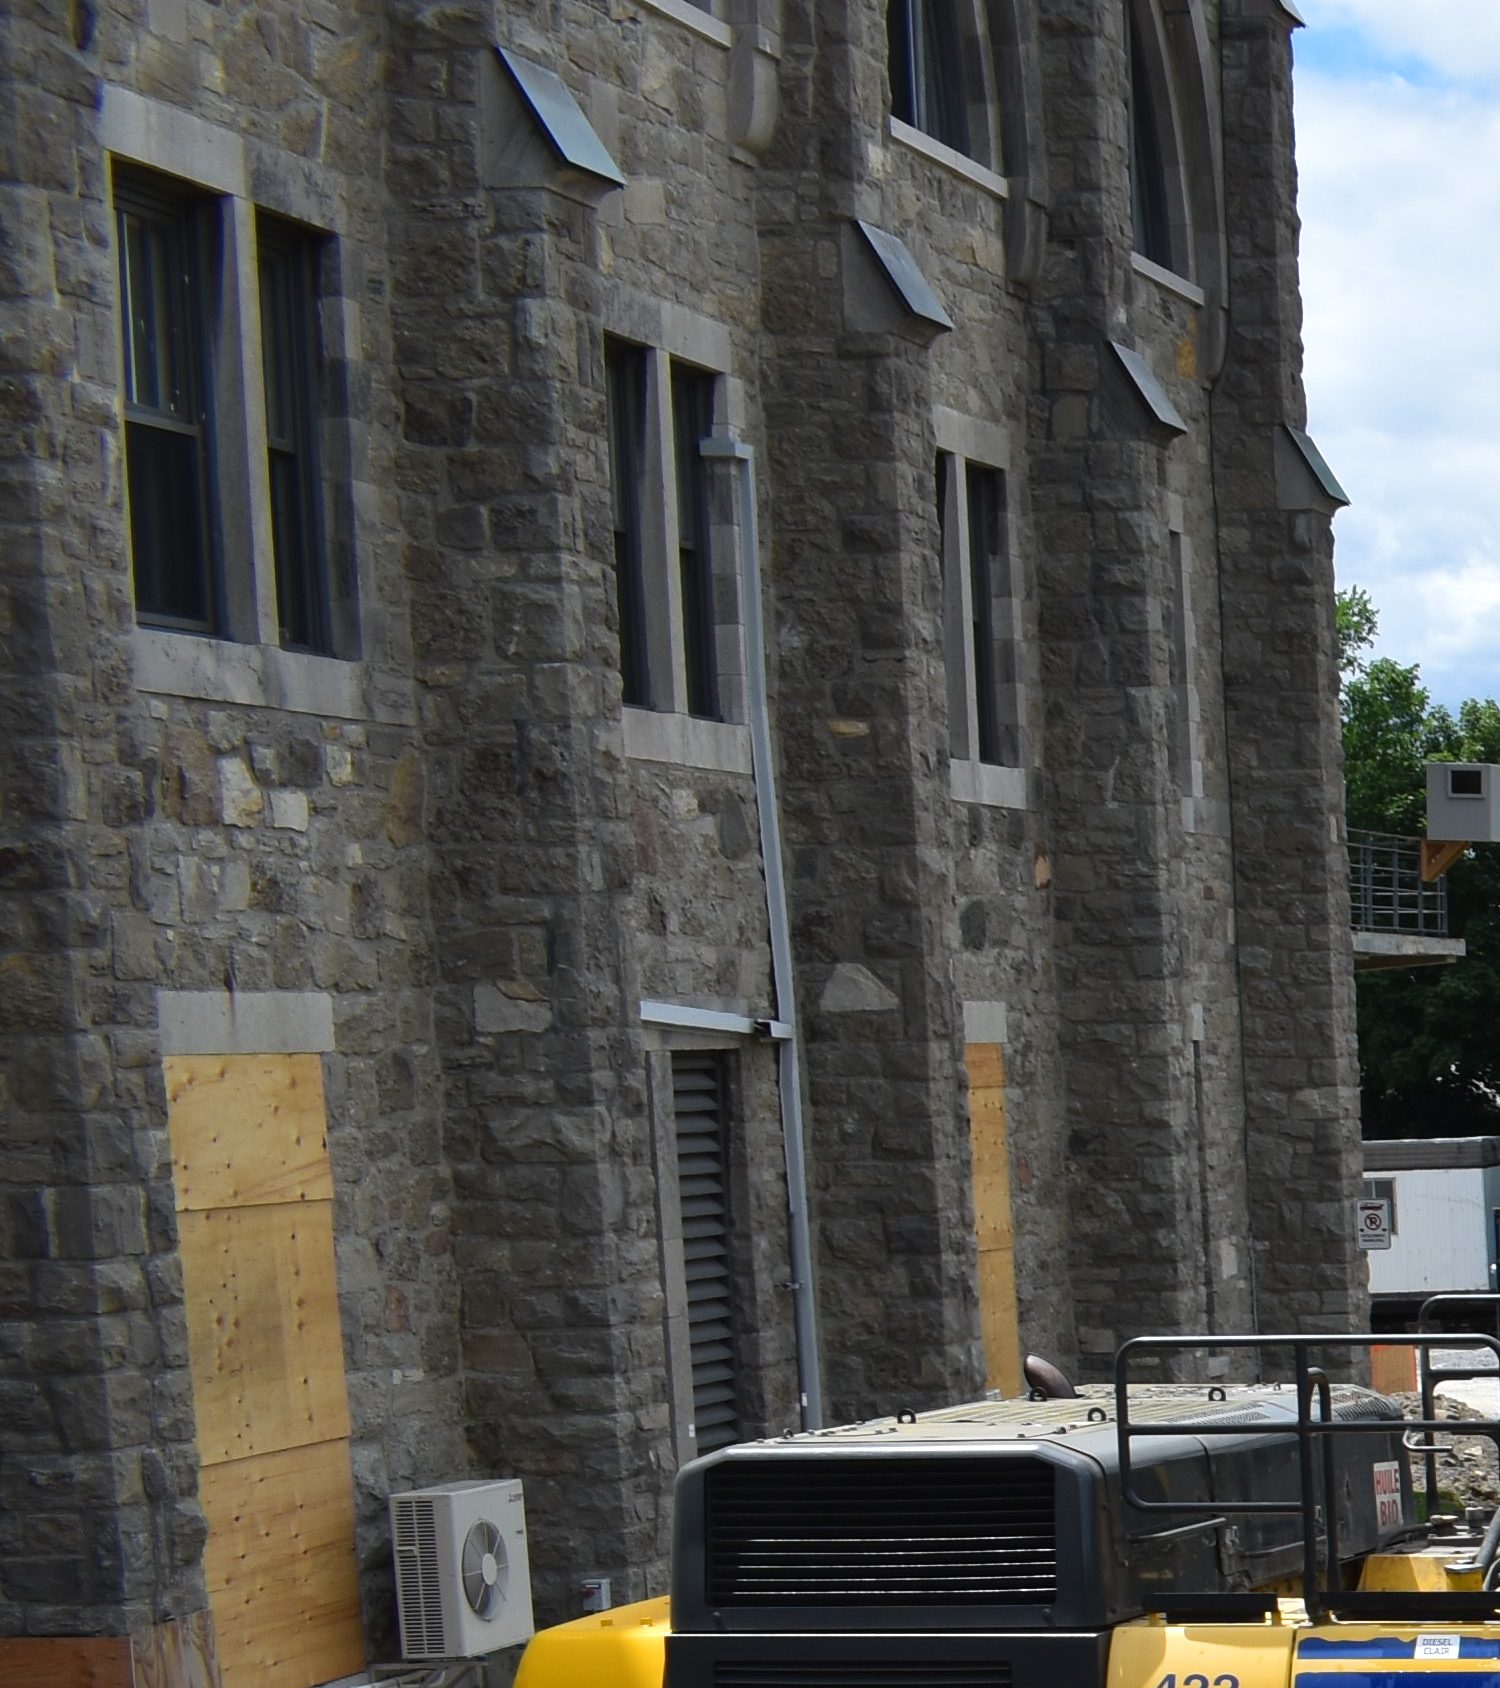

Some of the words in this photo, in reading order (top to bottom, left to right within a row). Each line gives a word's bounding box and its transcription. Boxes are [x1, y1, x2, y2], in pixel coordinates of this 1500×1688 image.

[1380, 1499, 1399, 1526] BIO
[1422, 1638, 1453, 1646] DIESEL
[1423, 1647, 1450, 1655] CLAIR
